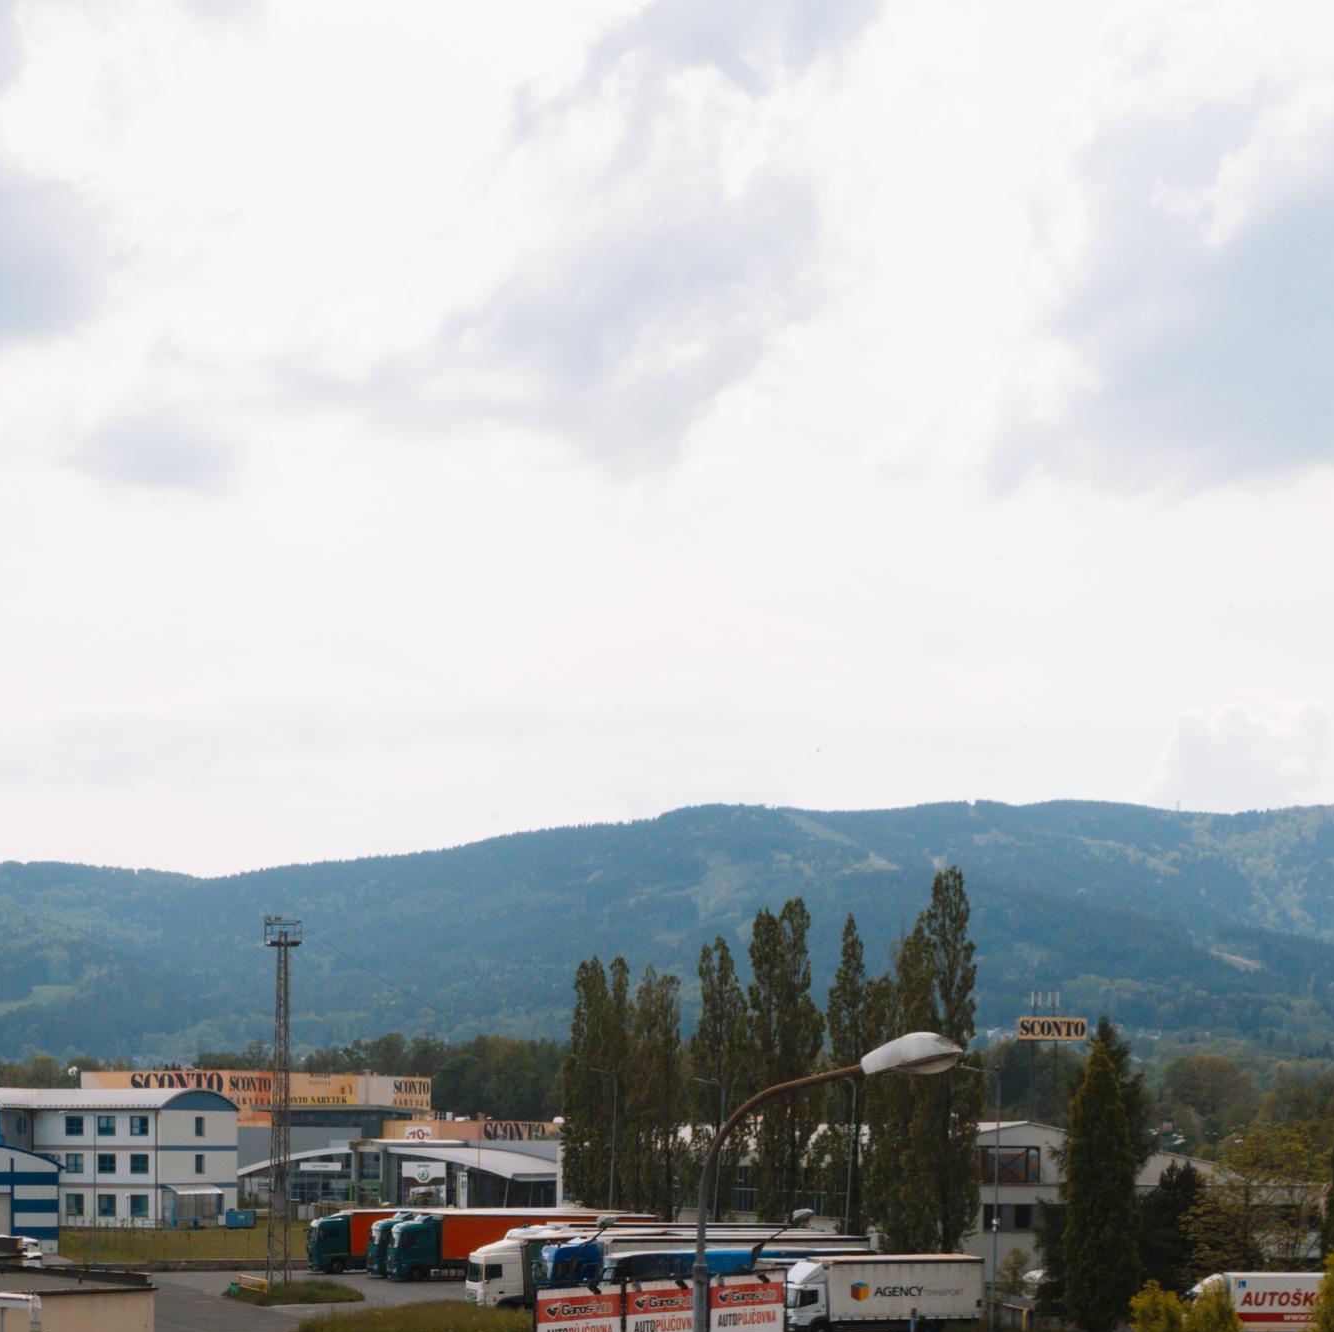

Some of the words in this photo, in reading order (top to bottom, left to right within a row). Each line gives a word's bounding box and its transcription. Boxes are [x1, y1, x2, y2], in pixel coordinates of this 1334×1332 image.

[1019, 1020, 1086, 1037] SCONTO
[130, 1072, 224, 1093] SCONTO
[229, 1076, 272, 1094] SCONTO
[393, 1079, 430, 1096] SCONTO
[874, 1286, 924, 1297] AGENCY
[1241, 1288, 1318, 1307] AUTOŠK
[717, 1308, 777, 1328] AUTOPŮJČOVNA
